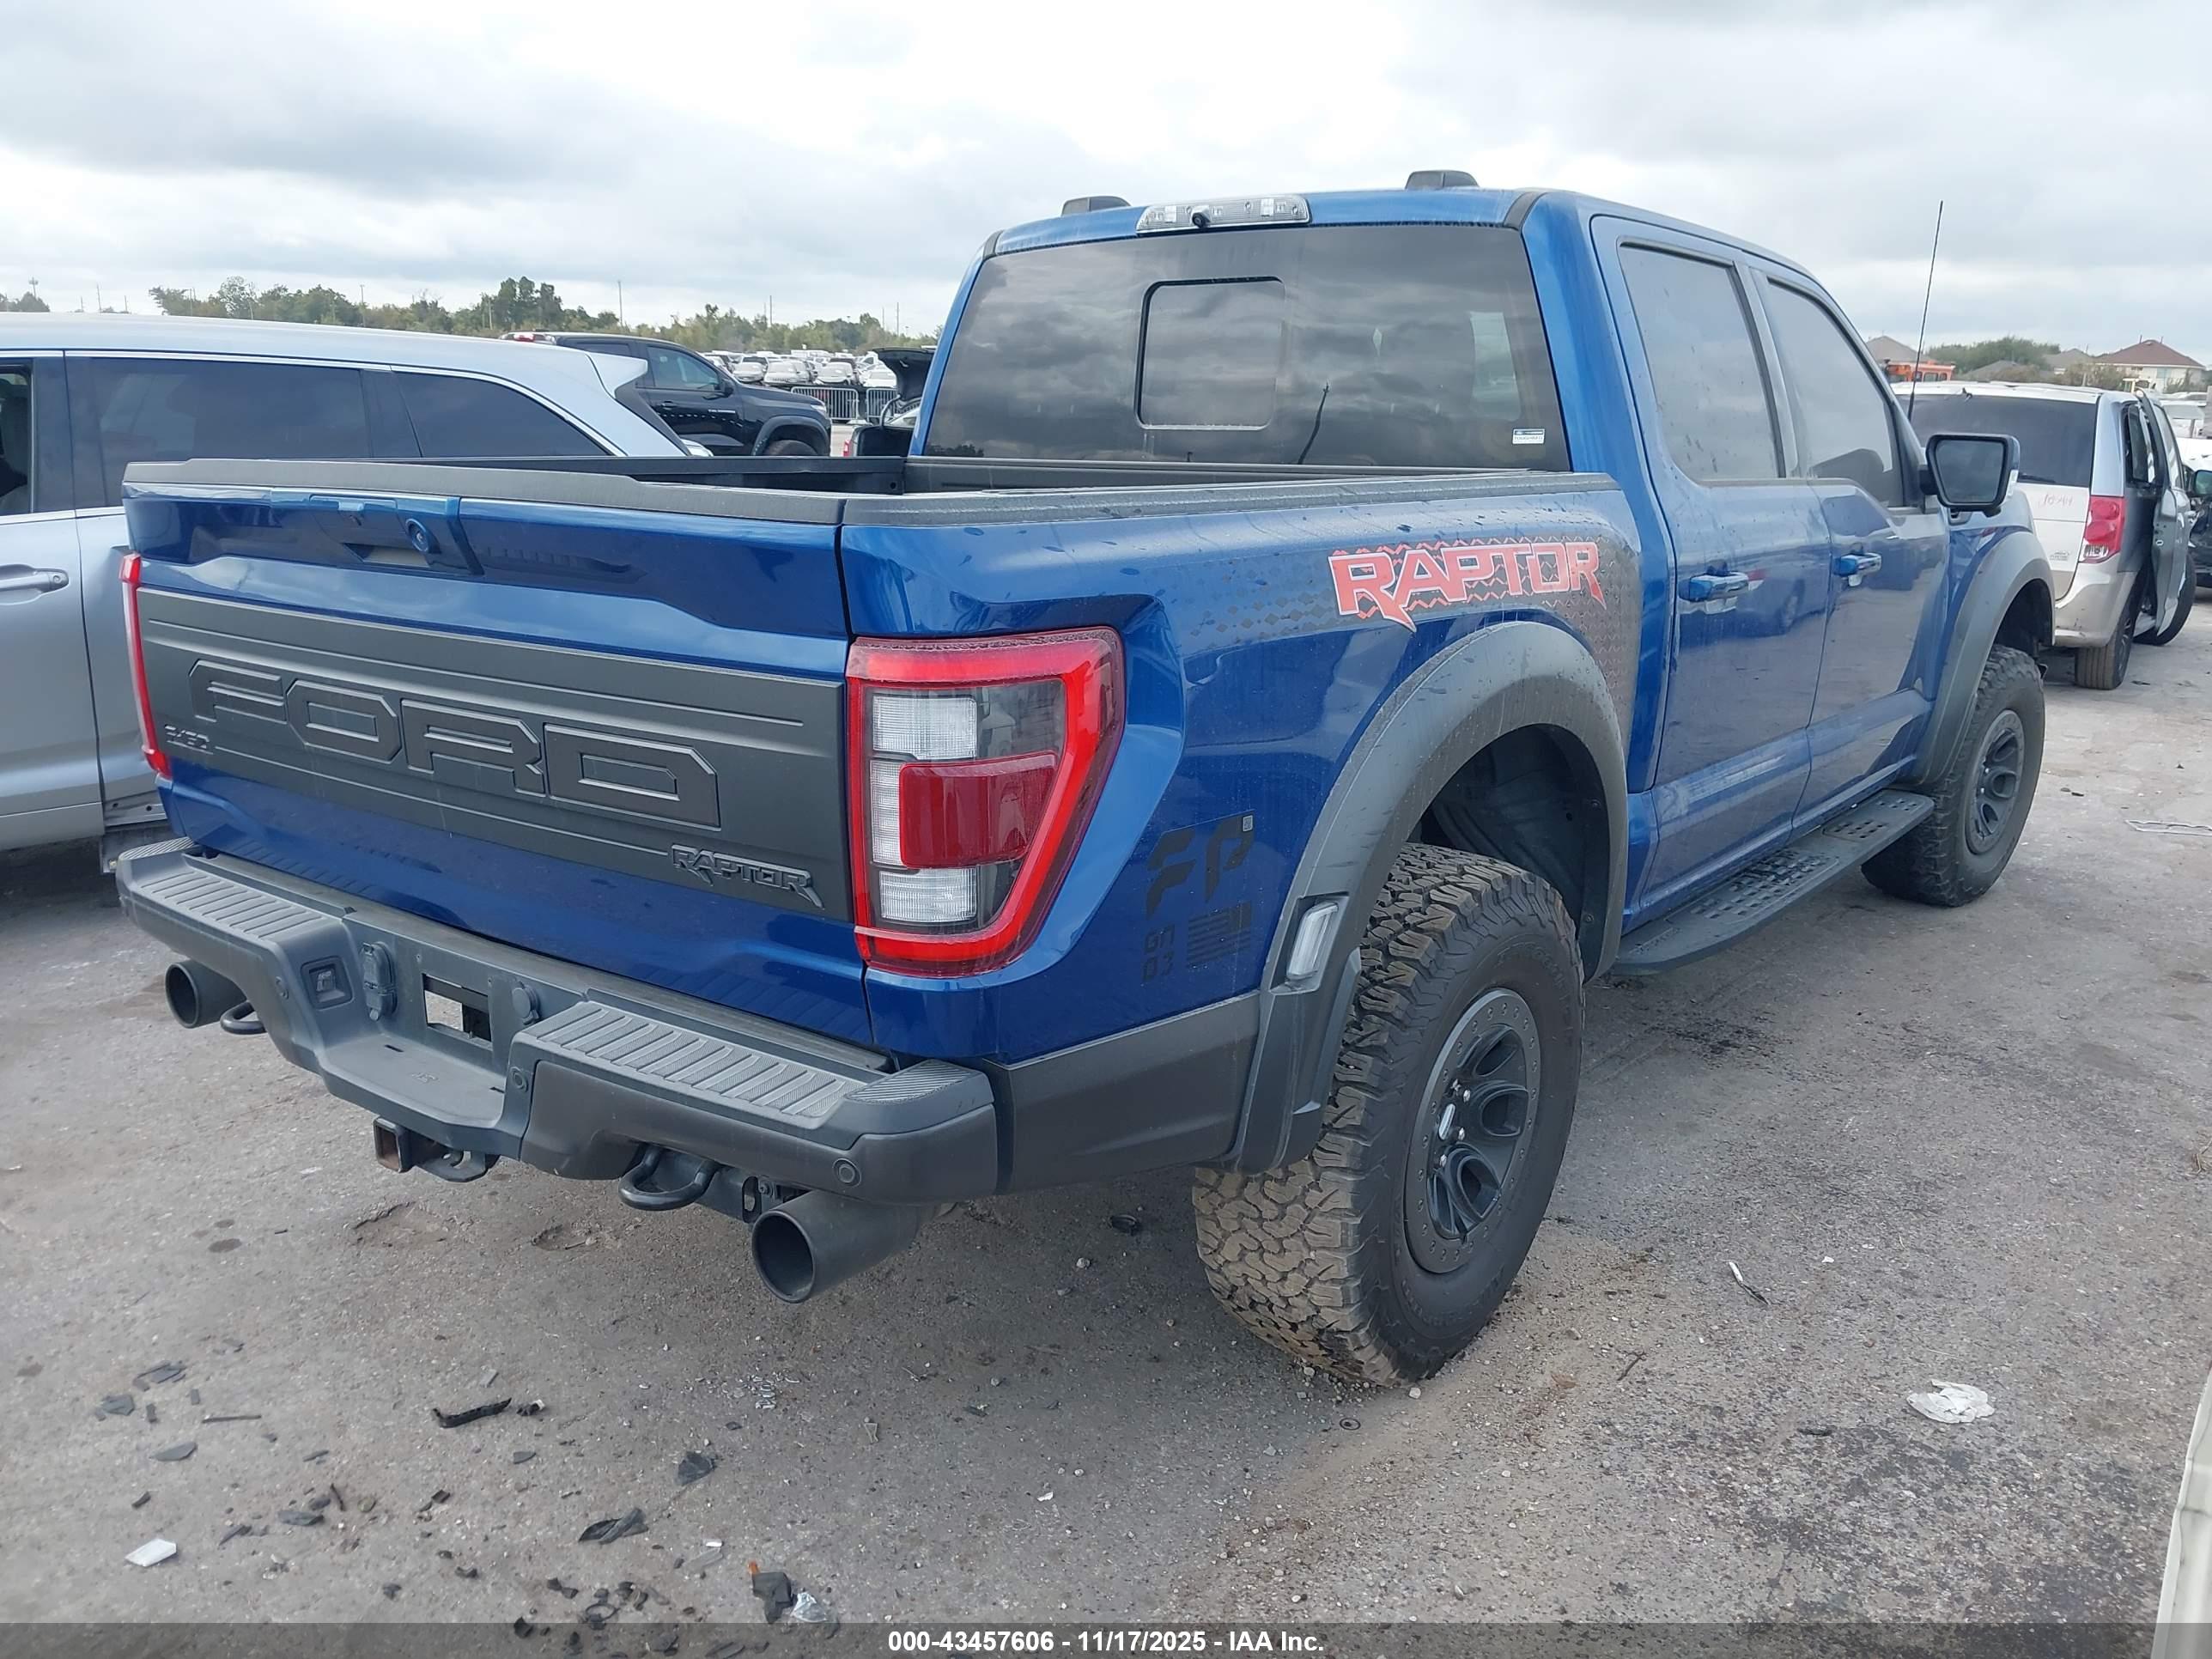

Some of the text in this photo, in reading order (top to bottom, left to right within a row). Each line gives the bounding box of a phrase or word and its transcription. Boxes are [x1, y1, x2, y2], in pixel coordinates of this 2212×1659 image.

[1328, 542, 1607, 632] RAPTOR
[188, 658, 720, 830] FORD
[672, 843, 825, 910] RAPTOR
[1145, 811, 1256, 921] FP
